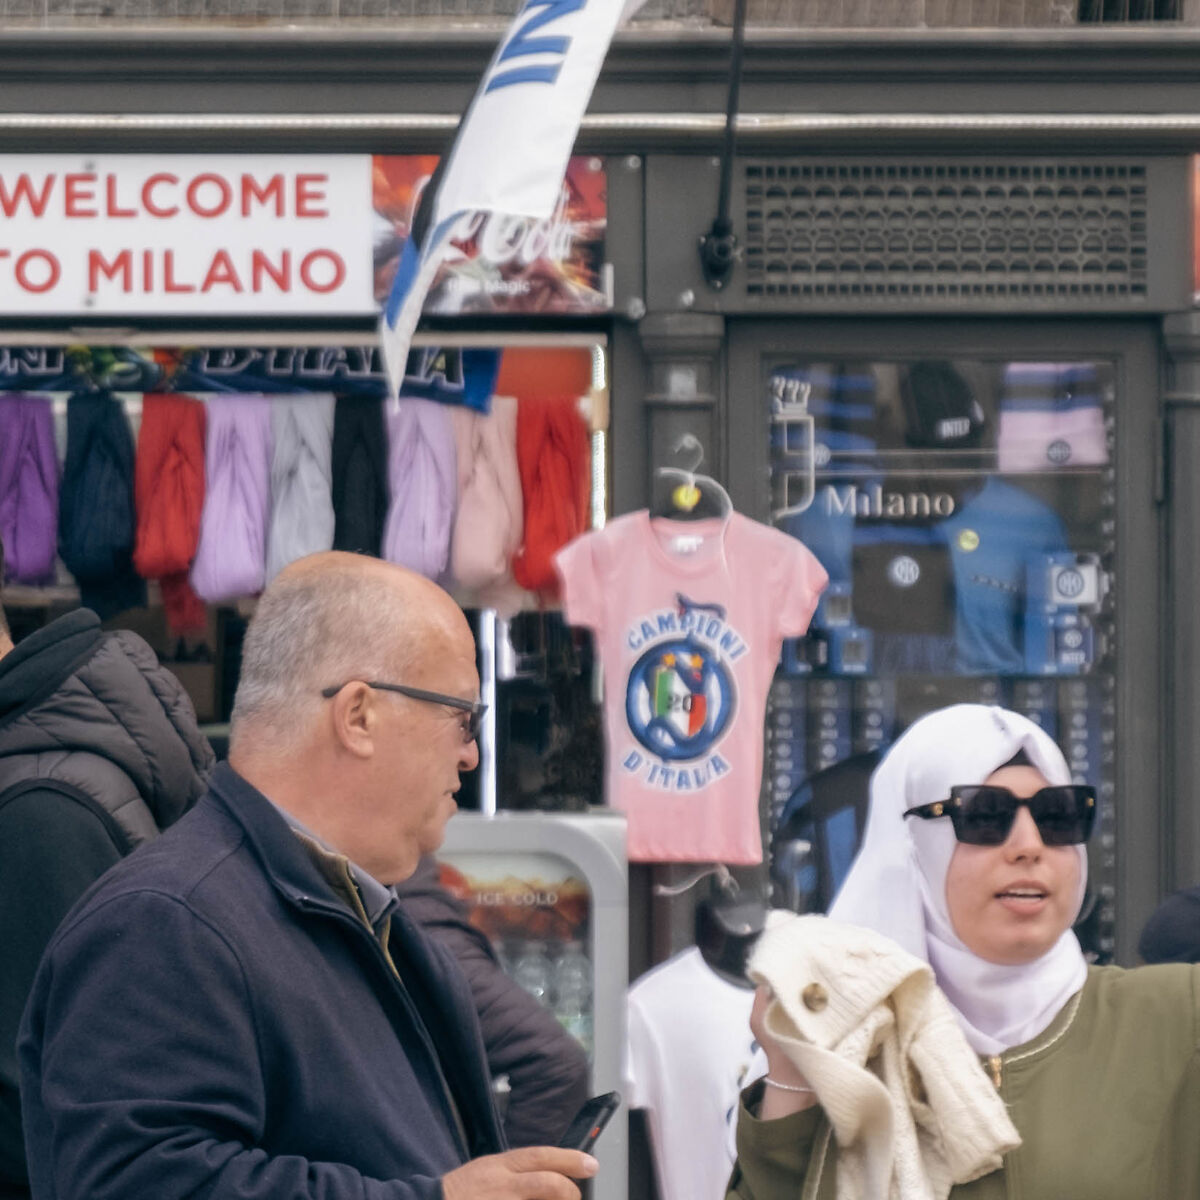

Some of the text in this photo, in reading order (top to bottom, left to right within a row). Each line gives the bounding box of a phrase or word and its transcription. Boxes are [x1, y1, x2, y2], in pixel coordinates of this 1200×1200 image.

[0, 173, 329, 219] WELCOME
[0, 248, 346, 294] O MILANO
[826, 484, 955, 516] Milano
[627, 611, 747, 660] CAMPIONI
[624, 750, 729, 791] D'ITALIA
[477, 891, 559, 905] ICE COLD
